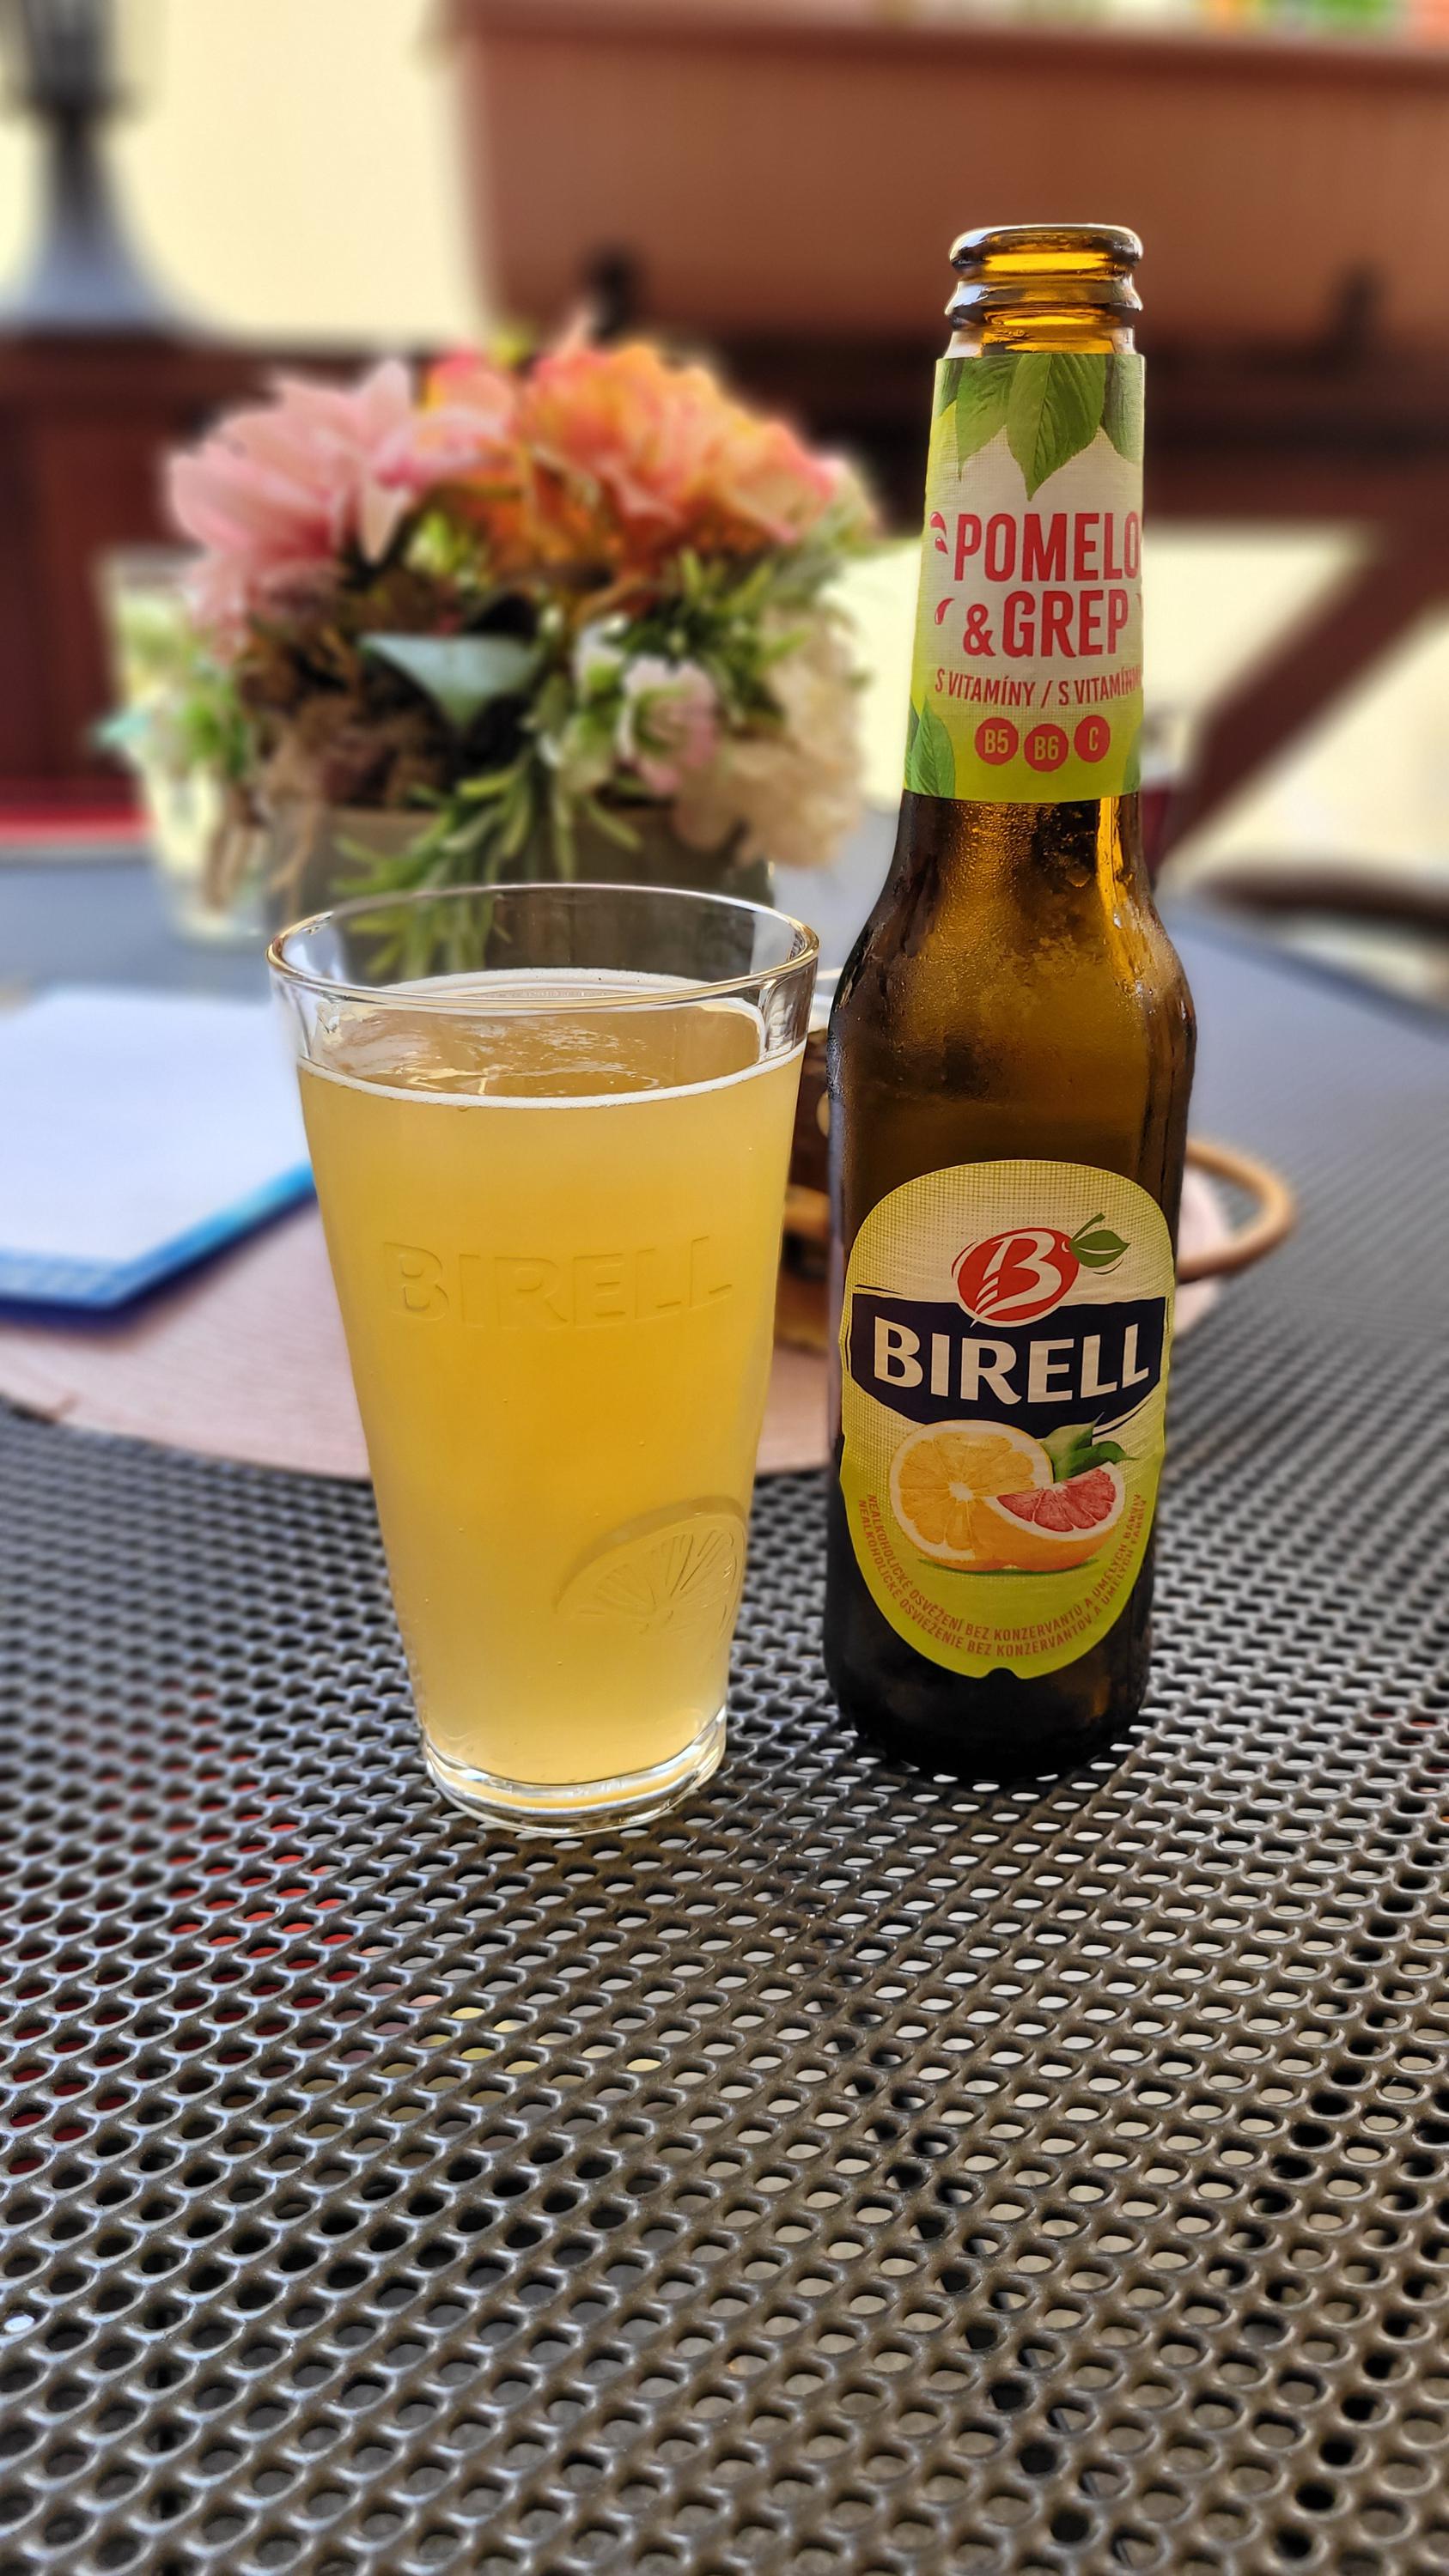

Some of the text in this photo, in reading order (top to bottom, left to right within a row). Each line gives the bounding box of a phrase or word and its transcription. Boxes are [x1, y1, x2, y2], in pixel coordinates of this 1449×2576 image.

[954, 512, 1141, 582] POMELO
[962, 589, 1129, 658] &GREP
[935, 668, 945, 692] S
[948, 671, 1036, 707] VITAMÍNY
[1058, 681, 1069, 706] S
[984, 729, 1009, 755] B5
[1034, 736, 1059, 761] B6
[1088, 726, 1099, 751] C
[383, 1236, 733, 1330] BIRELL
[874, 1315, 1149, 1405] BIRELL
[965, 1624, 989, 1639] BEZ
[967, 1641, 991, 1656] BEZ
[997, 1614, 1093, 1657] KONZERVANTOV
